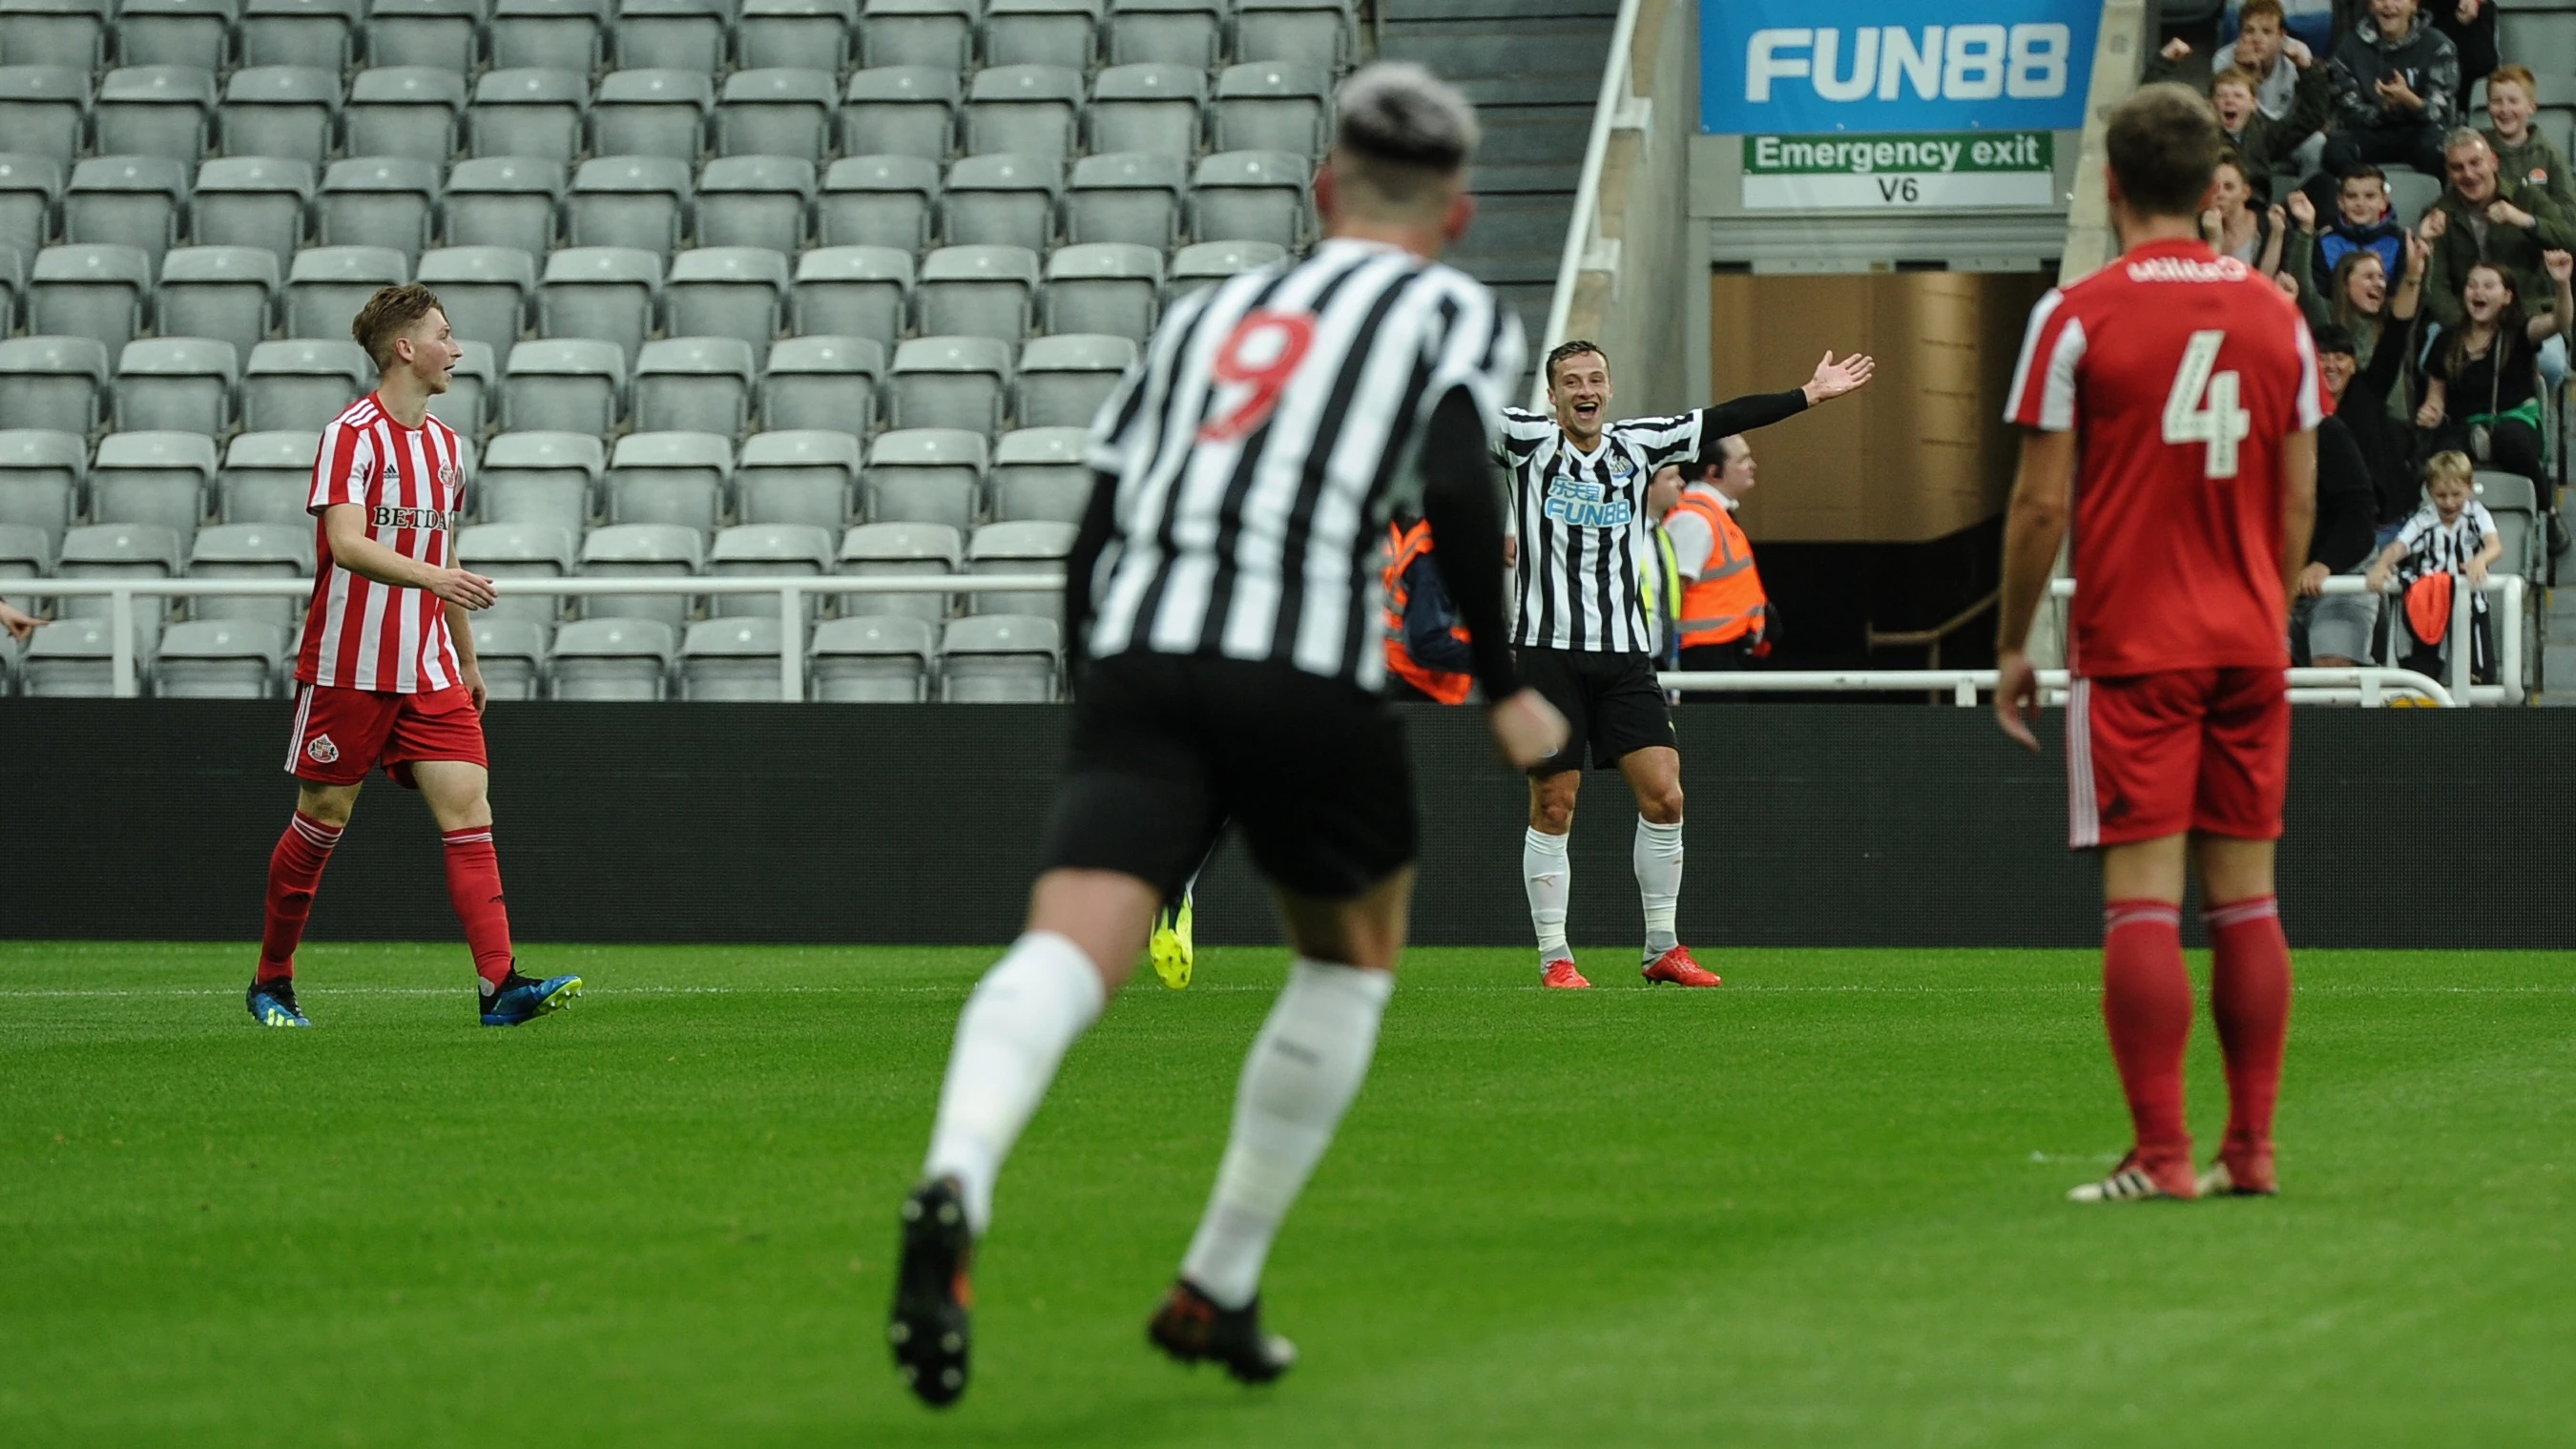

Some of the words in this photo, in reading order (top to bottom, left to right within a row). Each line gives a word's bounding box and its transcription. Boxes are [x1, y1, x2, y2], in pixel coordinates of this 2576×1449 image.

[1745, 23, 2070, 102] FUN88
[1755, 136, 1961, 174] Emergency
[1970, 135, 2040, 166] exit
[1878, 177, 1920, 204] V6
[1195, 307, 1316, 441] 9
[2162, 329, 2251, 480] 4
[372, 507, 448, 530] BETDA
[1547, 497, 1631, 527] FUN88
